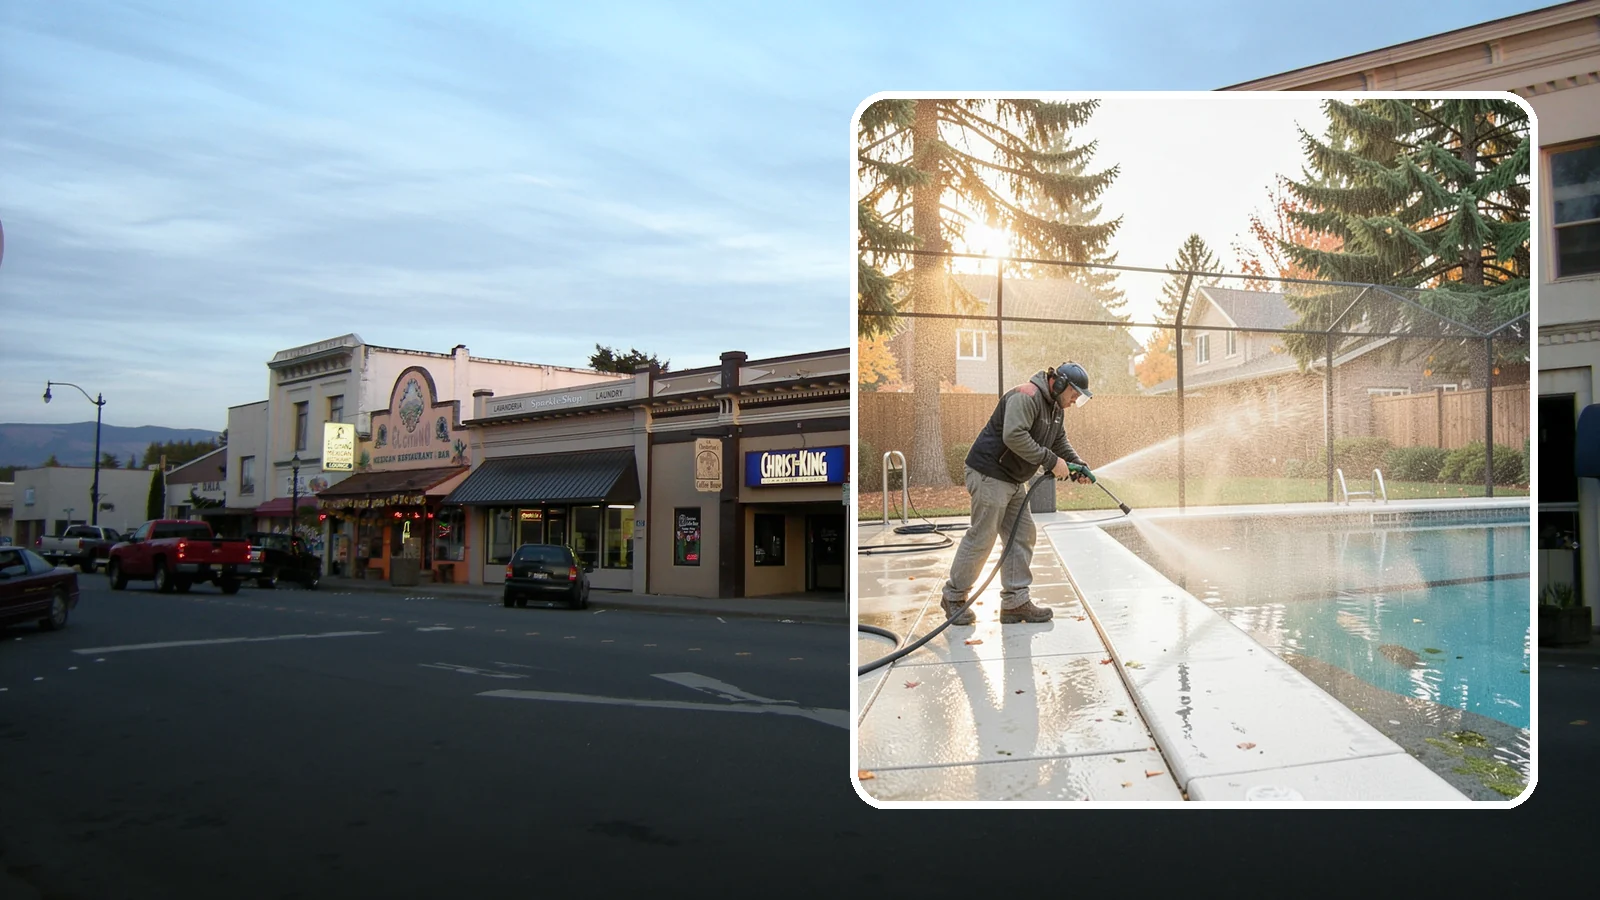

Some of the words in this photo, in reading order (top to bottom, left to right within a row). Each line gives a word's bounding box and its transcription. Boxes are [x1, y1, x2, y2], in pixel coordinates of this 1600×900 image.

[595, 388, 623, 400] LAUNDRY
[493, 402, 522, 413] LAVANDERIA
[531, 397, 561, 409] Sparkle
[562, 394, 582, 406] Shop
[373, 454, 396, 464] MEXICAN
[398, 451, 433, 462] RESTAURANT
[438, 450, 450, 459] BAR
[761, 452, 797, 478] CHRIST
[799, 450, 827, 476] KING
